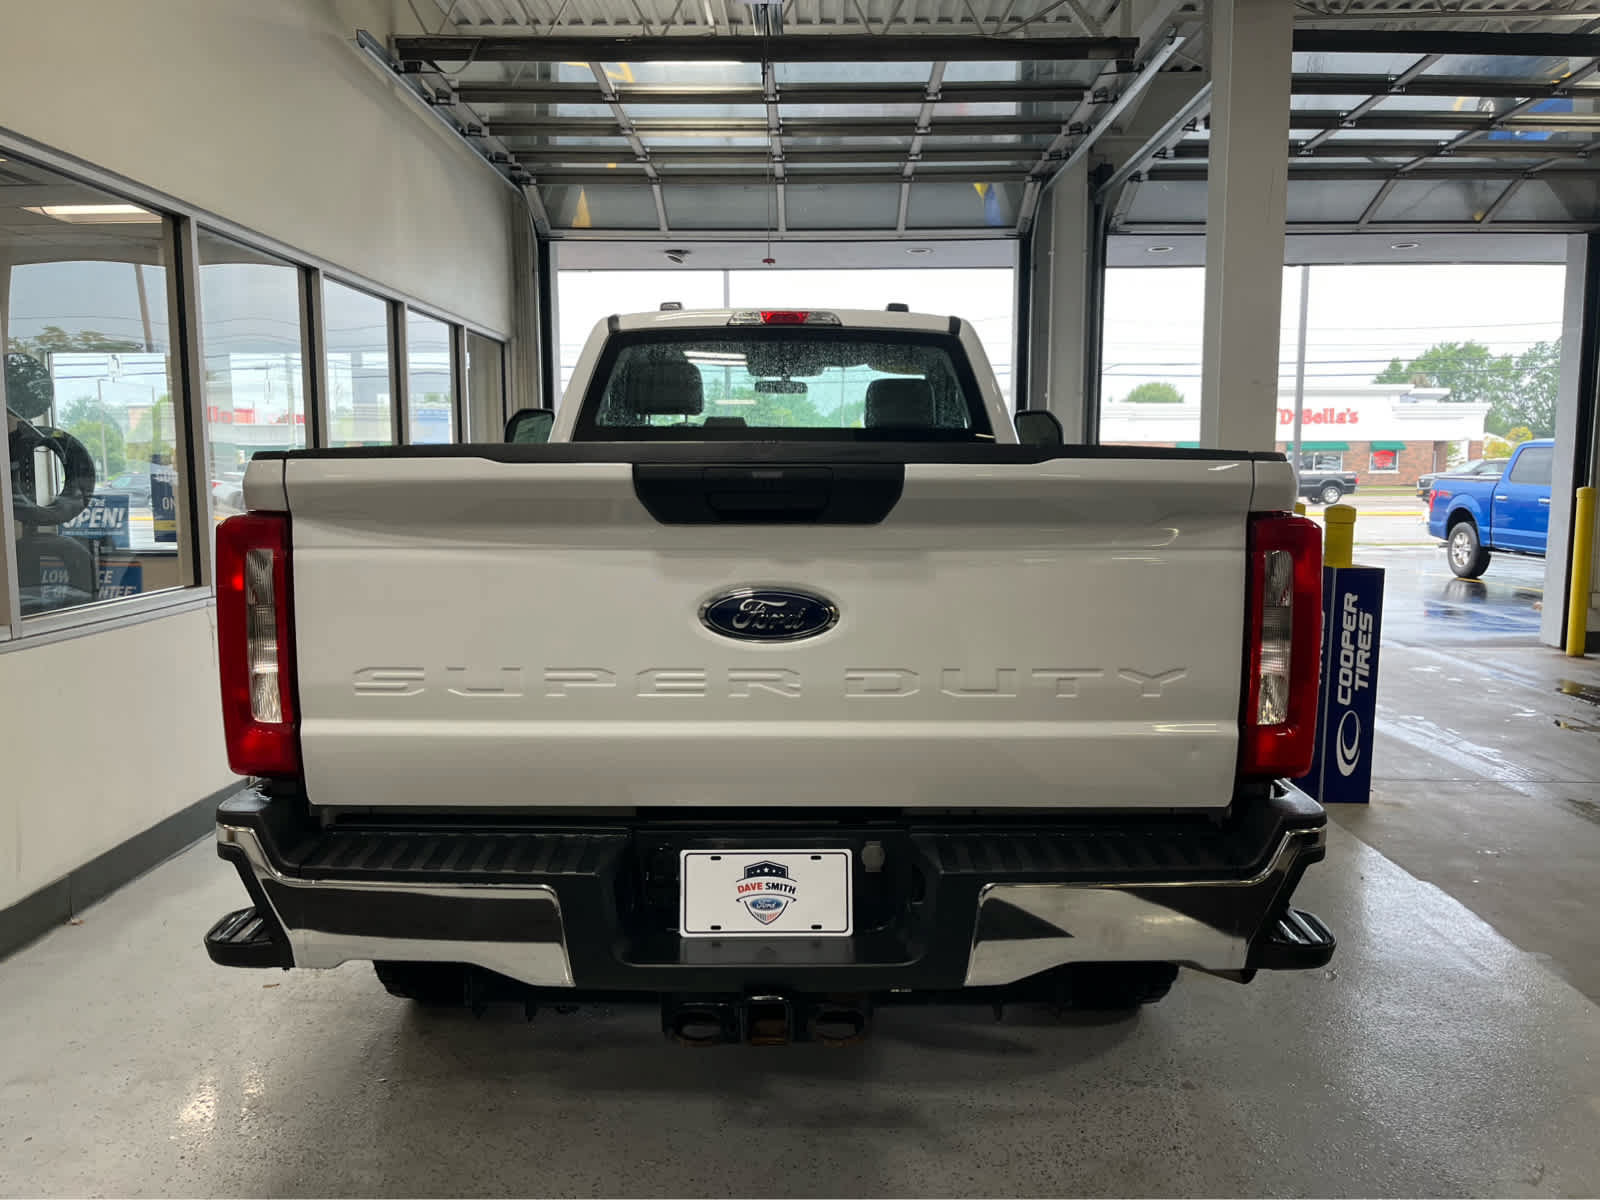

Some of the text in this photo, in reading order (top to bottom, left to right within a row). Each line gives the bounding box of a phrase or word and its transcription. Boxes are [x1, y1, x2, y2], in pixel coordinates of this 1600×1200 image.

[1278, 408, 1359, 424] DBella's
[732, 599, 806, 629] Ford
[1337, 592, 1359, 706] COOPER
[1354, 611, 1374, 691] TIRES
[354, 666, 1187, 697] SUPER DUTY
[737, 882, 796, 894] DAVE SMITH
[756, 899, 778, 909] Ford
